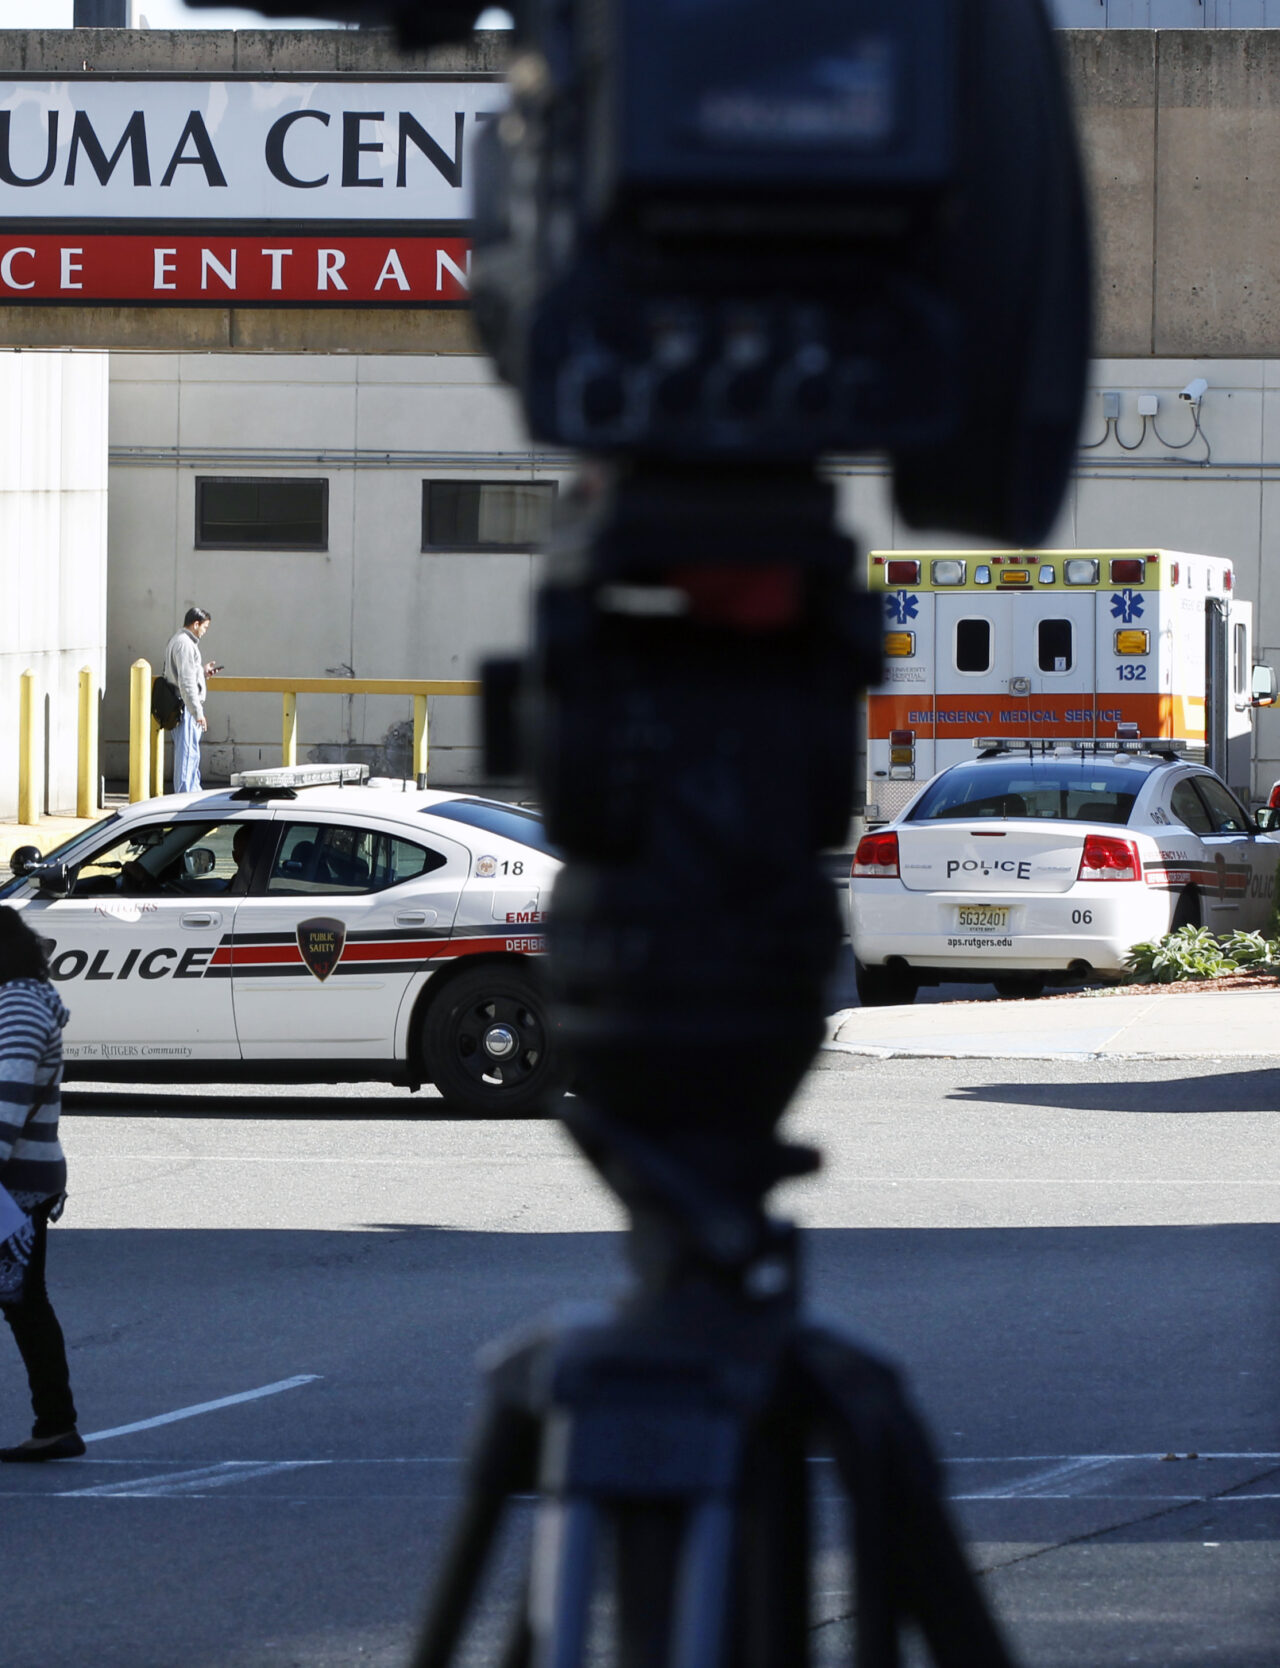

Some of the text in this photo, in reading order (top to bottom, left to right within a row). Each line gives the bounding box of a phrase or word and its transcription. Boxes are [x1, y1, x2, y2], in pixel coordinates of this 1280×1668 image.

[264, 108, 506, 189] CEN
[1116, 664, 1147, 681] 132
[908, 708, 1122, 724] EMERGENCY MEDICAL SERVICE
[500, 860, 524, 876] 18
[947, 859, 1032, 880] POLICE
[959, 910, 1006, 927] SG32401
[1071, 909, 1093, 925] 06
[310, 932, 335, 942] PUBLIC
[947, 936, 1013, 949] aps.rutgers.edu
[309, 943, 335, 953] SAFETY
[83, 1044, 98, 1056] The
[101, 1043, 139, 1058] RUTGERS
[141, 1043, 193, 1057] Community
